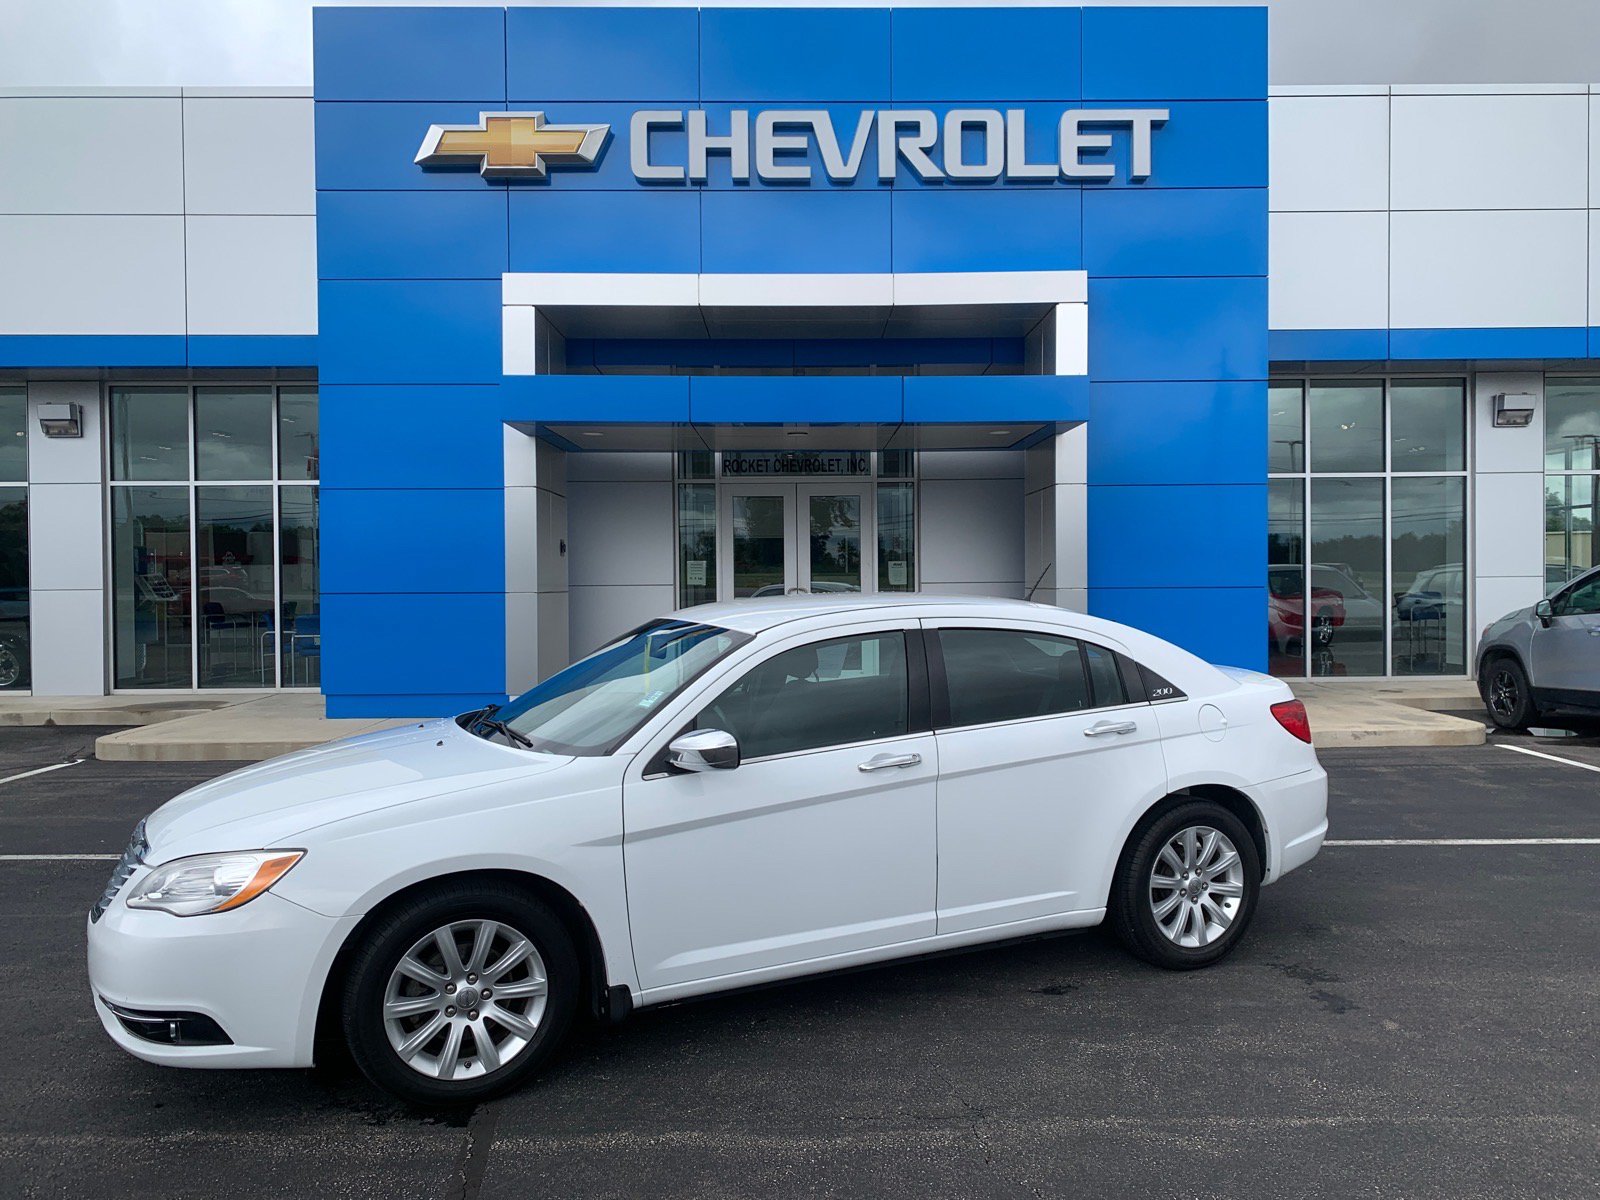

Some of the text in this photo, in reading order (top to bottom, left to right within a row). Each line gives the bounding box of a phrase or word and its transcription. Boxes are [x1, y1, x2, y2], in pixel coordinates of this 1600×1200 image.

[630, 109, 1169, 181] CHEVROLET
[723, 458, 869, 474] ROCKET CHEVROLET, INC.
[1152, 687, 1173, 697] 200
